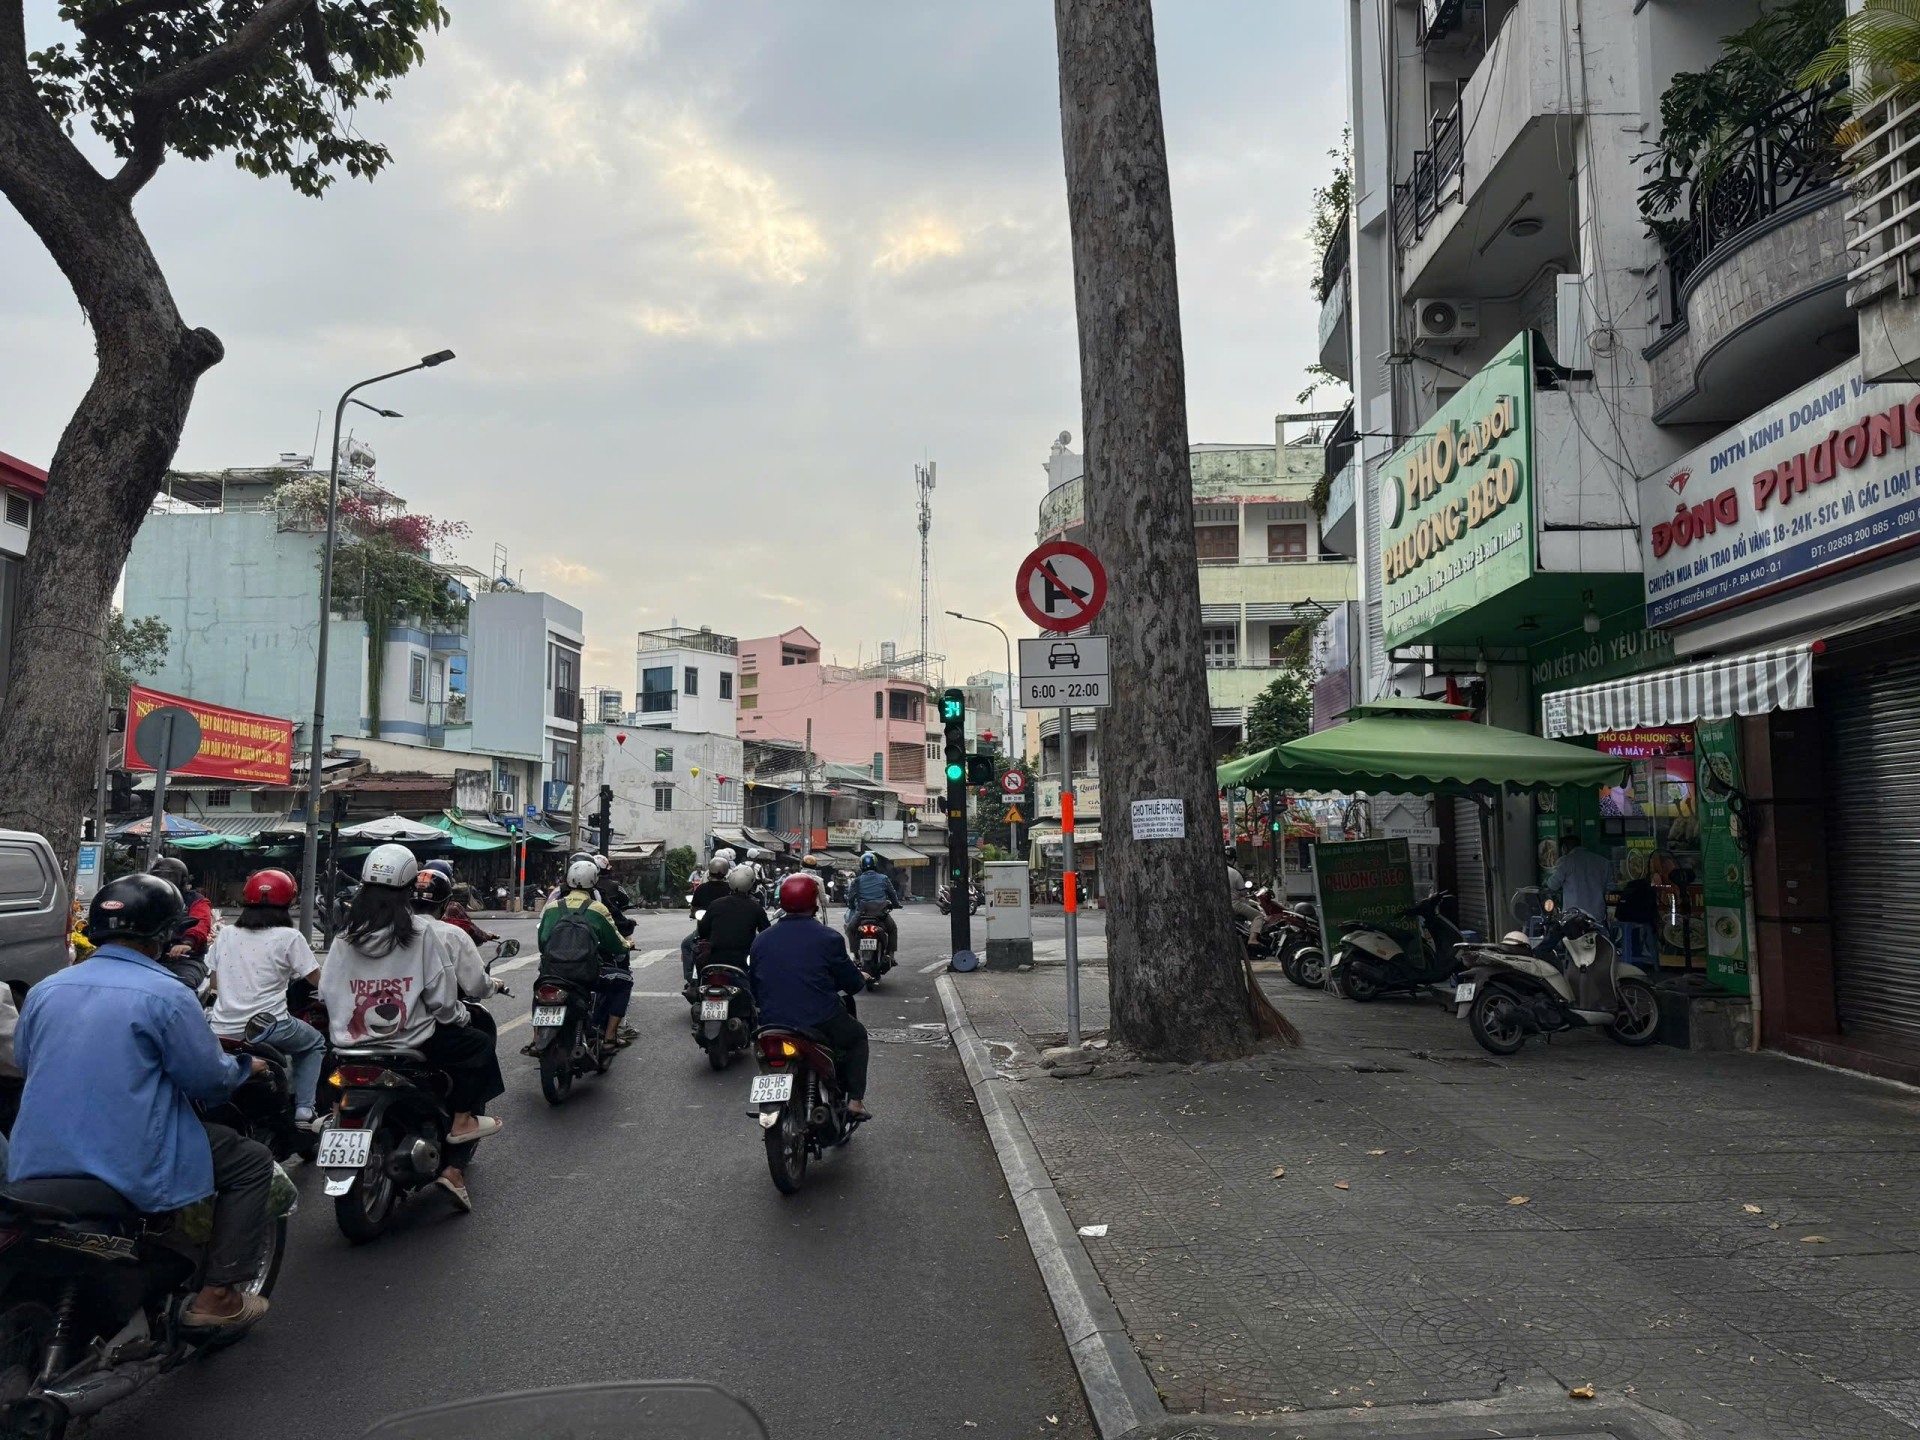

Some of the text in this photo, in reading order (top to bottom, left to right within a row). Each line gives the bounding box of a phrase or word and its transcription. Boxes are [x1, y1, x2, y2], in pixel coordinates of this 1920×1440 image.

[1710, 440, 1746, 474] DNTN
[1749, 419, 1784, 454] KINH
[1790, 384, 1846, 433] DOANH
[1384, 455, 1518, 584] PHƯƠNG BÉO
[1651, 487, 1739, 558] ĐÔNG
[1648, 569, 1675, 594] CHUYÊN
[1677, 564, 1693, 584] MUA
[1694, 554, 1709, 577] BÁN
[1710, 547, 1731, 570] TRAO
[1733, 532, 1747, 561] ĐỔI
[1749, 531, 1771, 553] VÀNG
[1841, 490, 1855, 515] VÀ
[1858, 481, 1880, 509] CÁC
[1884, 469, 1911, 499] LOẠI
[1811, 545, 1826, 559] ĐT:
[1827, 534, 1853, 553] 02838
[1854, 527, 1871, 543] 200
[1872, 519, 1889, 536] 885
[1897, 509, 1915, 526] 090
[1664, 597, 1673, 613] SỐ
[1680, 587, 1705, 607] NGUYỄN
[1705, 584, 1719, 597] HUY
[1719, 578, 1729, 595] TỰ
[1739, 572, 1750, 585] ĐA
[1750, 566, 1765, 582] KAO
[1770, 560, 1782, 575] Q.1
[1554, 647, 1575, 678] KẾT
[1609, 631, 1637, 660] YÊU
[1031, 684, 1056, 699] 6:00
[1068, 682, 1099, 698] 22:00
[944, 700, 960, 718] 34
[1598, 731, 1617, 742] PHỞ
[1618, 731, 1633, 743] GÀ
[1625, 746, 1645, 756] MÂY
[1133, 800, 1183, 816] CHO THUÊ PHÒNG
[759, 1076, 787, 1089] 60-H5
[752, 1088, 789, 1102] 225.86
[328, 1132, 364, 1148] 72-C1
[320, 1149, 366, 1165] 563.46
